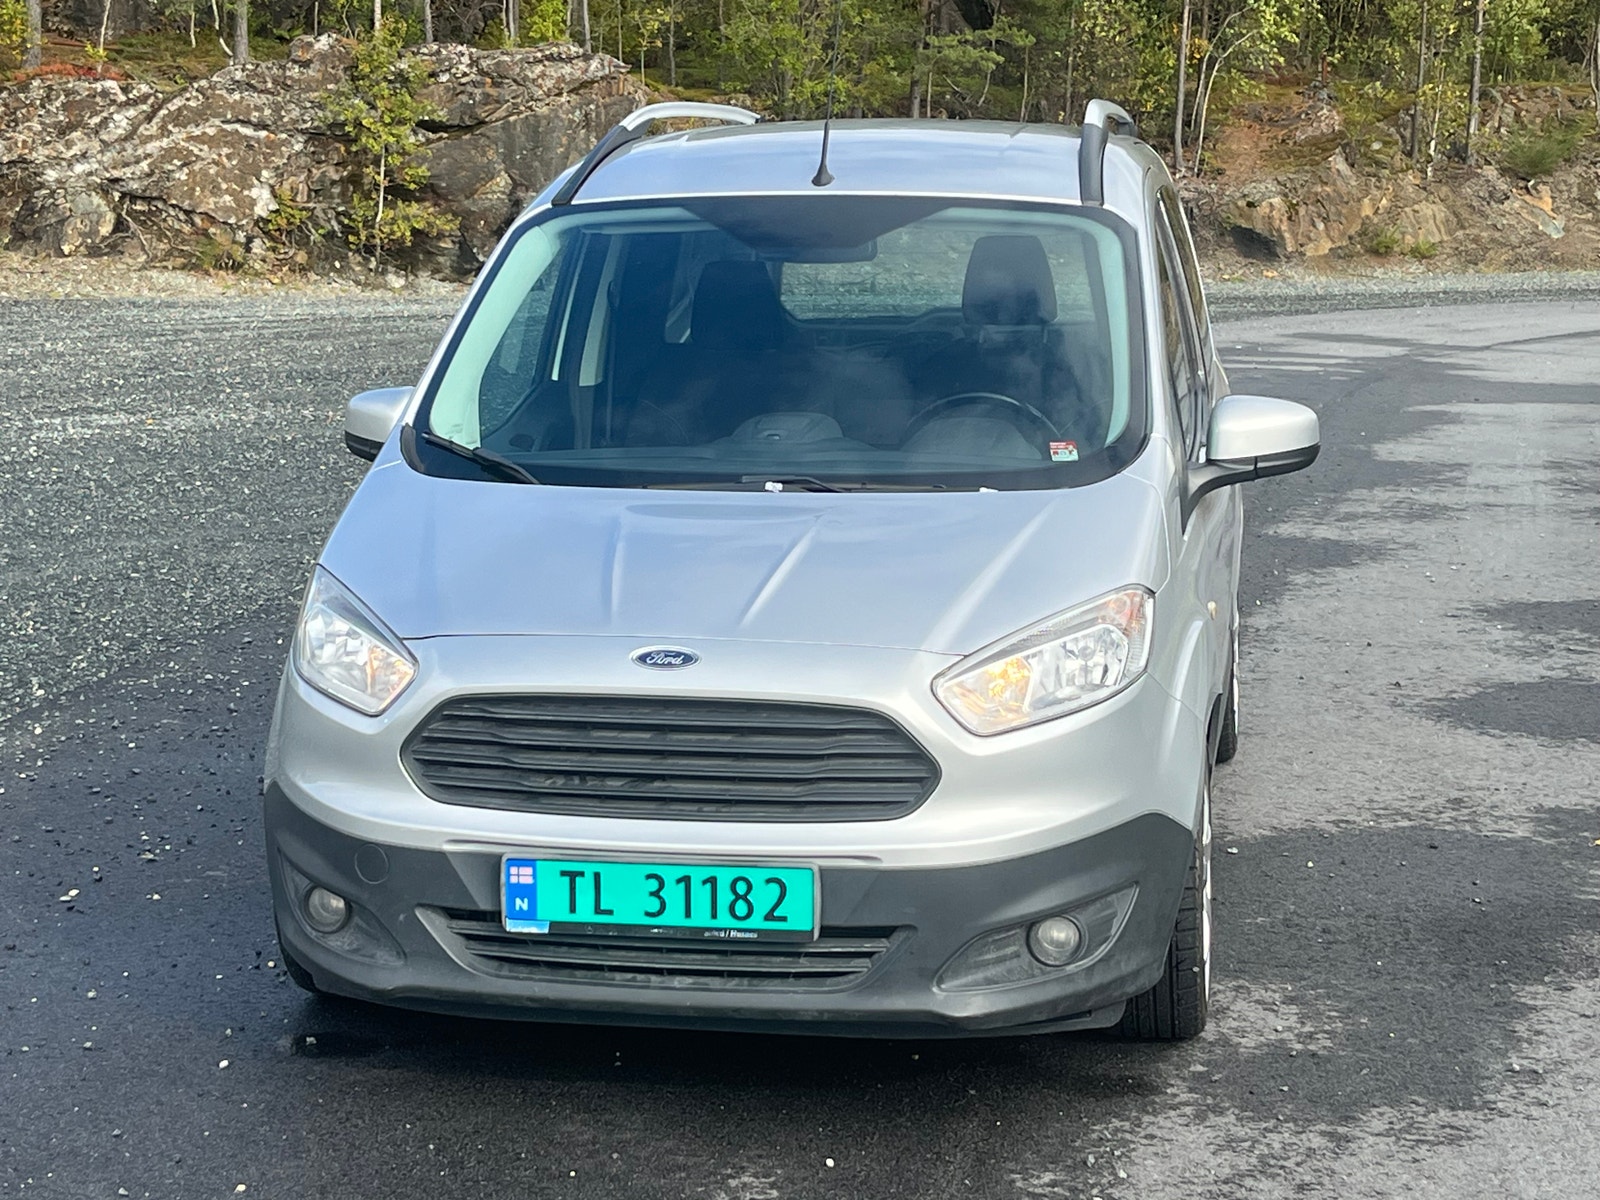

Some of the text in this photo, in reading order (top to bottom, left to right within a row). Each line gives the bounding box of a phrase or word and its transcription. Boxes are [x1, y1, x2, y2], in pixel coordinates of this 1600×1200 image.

[646, 651, 685, 665] Ford
[559, 869, 789, 922] TL 31182
[515, 897, 528, 911] N
